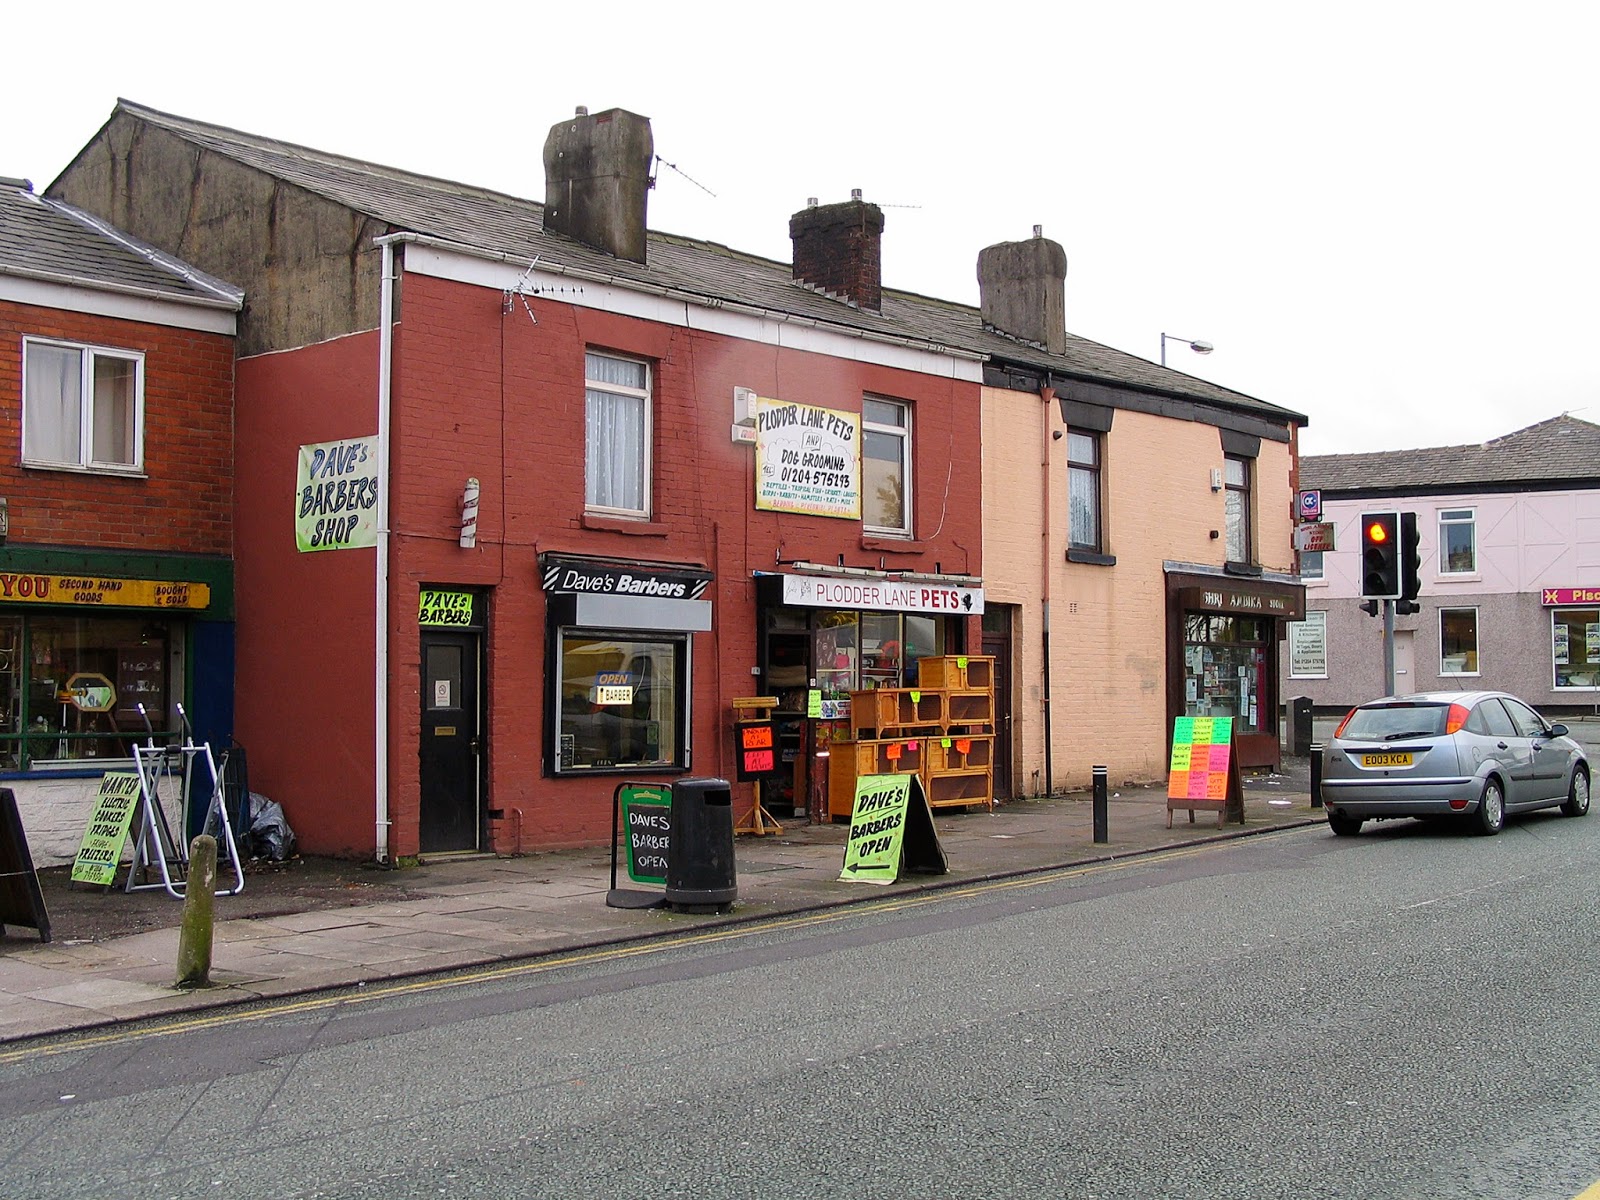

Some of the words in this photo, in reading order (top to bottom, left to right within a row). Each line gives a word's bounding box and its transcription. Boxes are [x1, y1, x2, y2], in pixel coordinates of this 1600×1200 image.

[759, 405, 798, 432] PLODDER
[800, 407, 826, 429] LANE
[826, 414, 853, 441] PETS
[806, 434, 820, 446] AND
[781, 449, 800, 466] DOG
[801, 452, 846, 471] GROOMING
[300, 476, 378, 519] BARBERS
[310, 514, 359, 547] SHOP
[0, 574, 50, 598] YOU
[58, 579, 94, 590] SECOND
[97, 581, 123, 591] HAND
[155, 585, 188, 595] BOUGHT
[562, 570, 615, 592] Dave's
[615, 574, 686, 597] Barbers
[73, 592, 103, 602] GOODS
[165, 596, 188, 604] SOLD
[816, 583, 881, 606] PLODDER
[884, 588, 917, 607] LANE
[921, 588, 960, 610] PETS
[419, 609, 471, 624] BARBERS
[599, 674, 628, 684] OPEN
[605, 689, 631, 701] BARBER
[1390, 754, 1408, 764] KCA
[858, 786, 904, 813] DAVE'S
[630, 812, 670, 830] DAVES
[851, 812, 902, 840] BARBERS
[860, 836, 892, 858] OPEN
